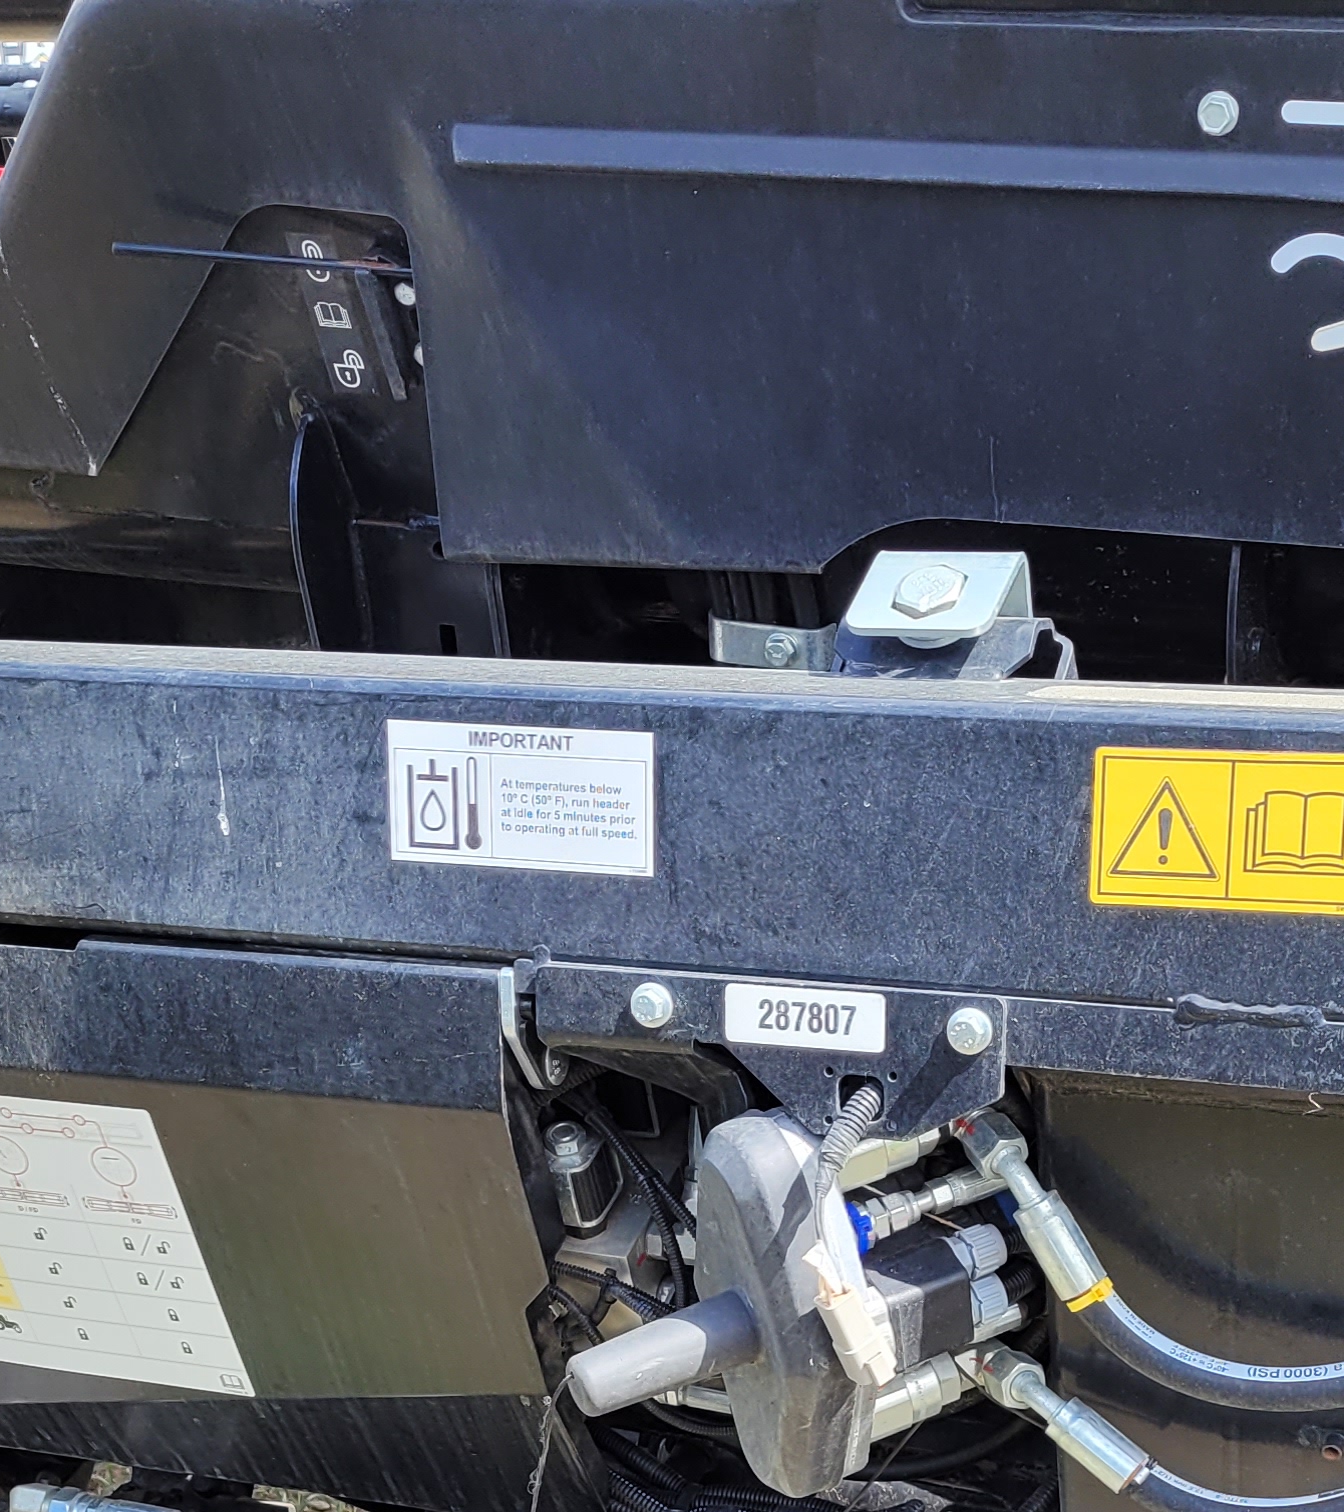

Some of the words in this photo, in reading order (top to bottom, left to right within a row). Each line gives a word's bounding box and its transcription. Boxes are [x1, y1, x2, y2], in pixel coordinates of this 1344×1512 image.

[468, 730, 574, 752] IMPORTANT
[500, 779, 513, 790] At
[515, 779, 588, 794] temperatures
[589, 784, 622, 796] below
[520, 794, 529, 804] C
[571, 799, 590, 808] run
[592, 798, 631, 810] header
[501, 809, 512, 818] at
[513, 808, 534, 819] idle
[536, 809, 552, 820] for
[553, 810, 561, 820] 5
[563, 811, 607, 823] minutes
[609, 813, 636, 827] prior
[501, 822, 512, 832] to
[514, 823, 566, 838] operating
[568, 826, 579, 836] at
[581, 824, 599, 837] full
[601, 828, 638, 841] speed.
[758, 998, 857, 1036] 287807
[1246, 1367, 1280, 1379] PSI)
[1283, 1366, 1329, 1379] (3000
